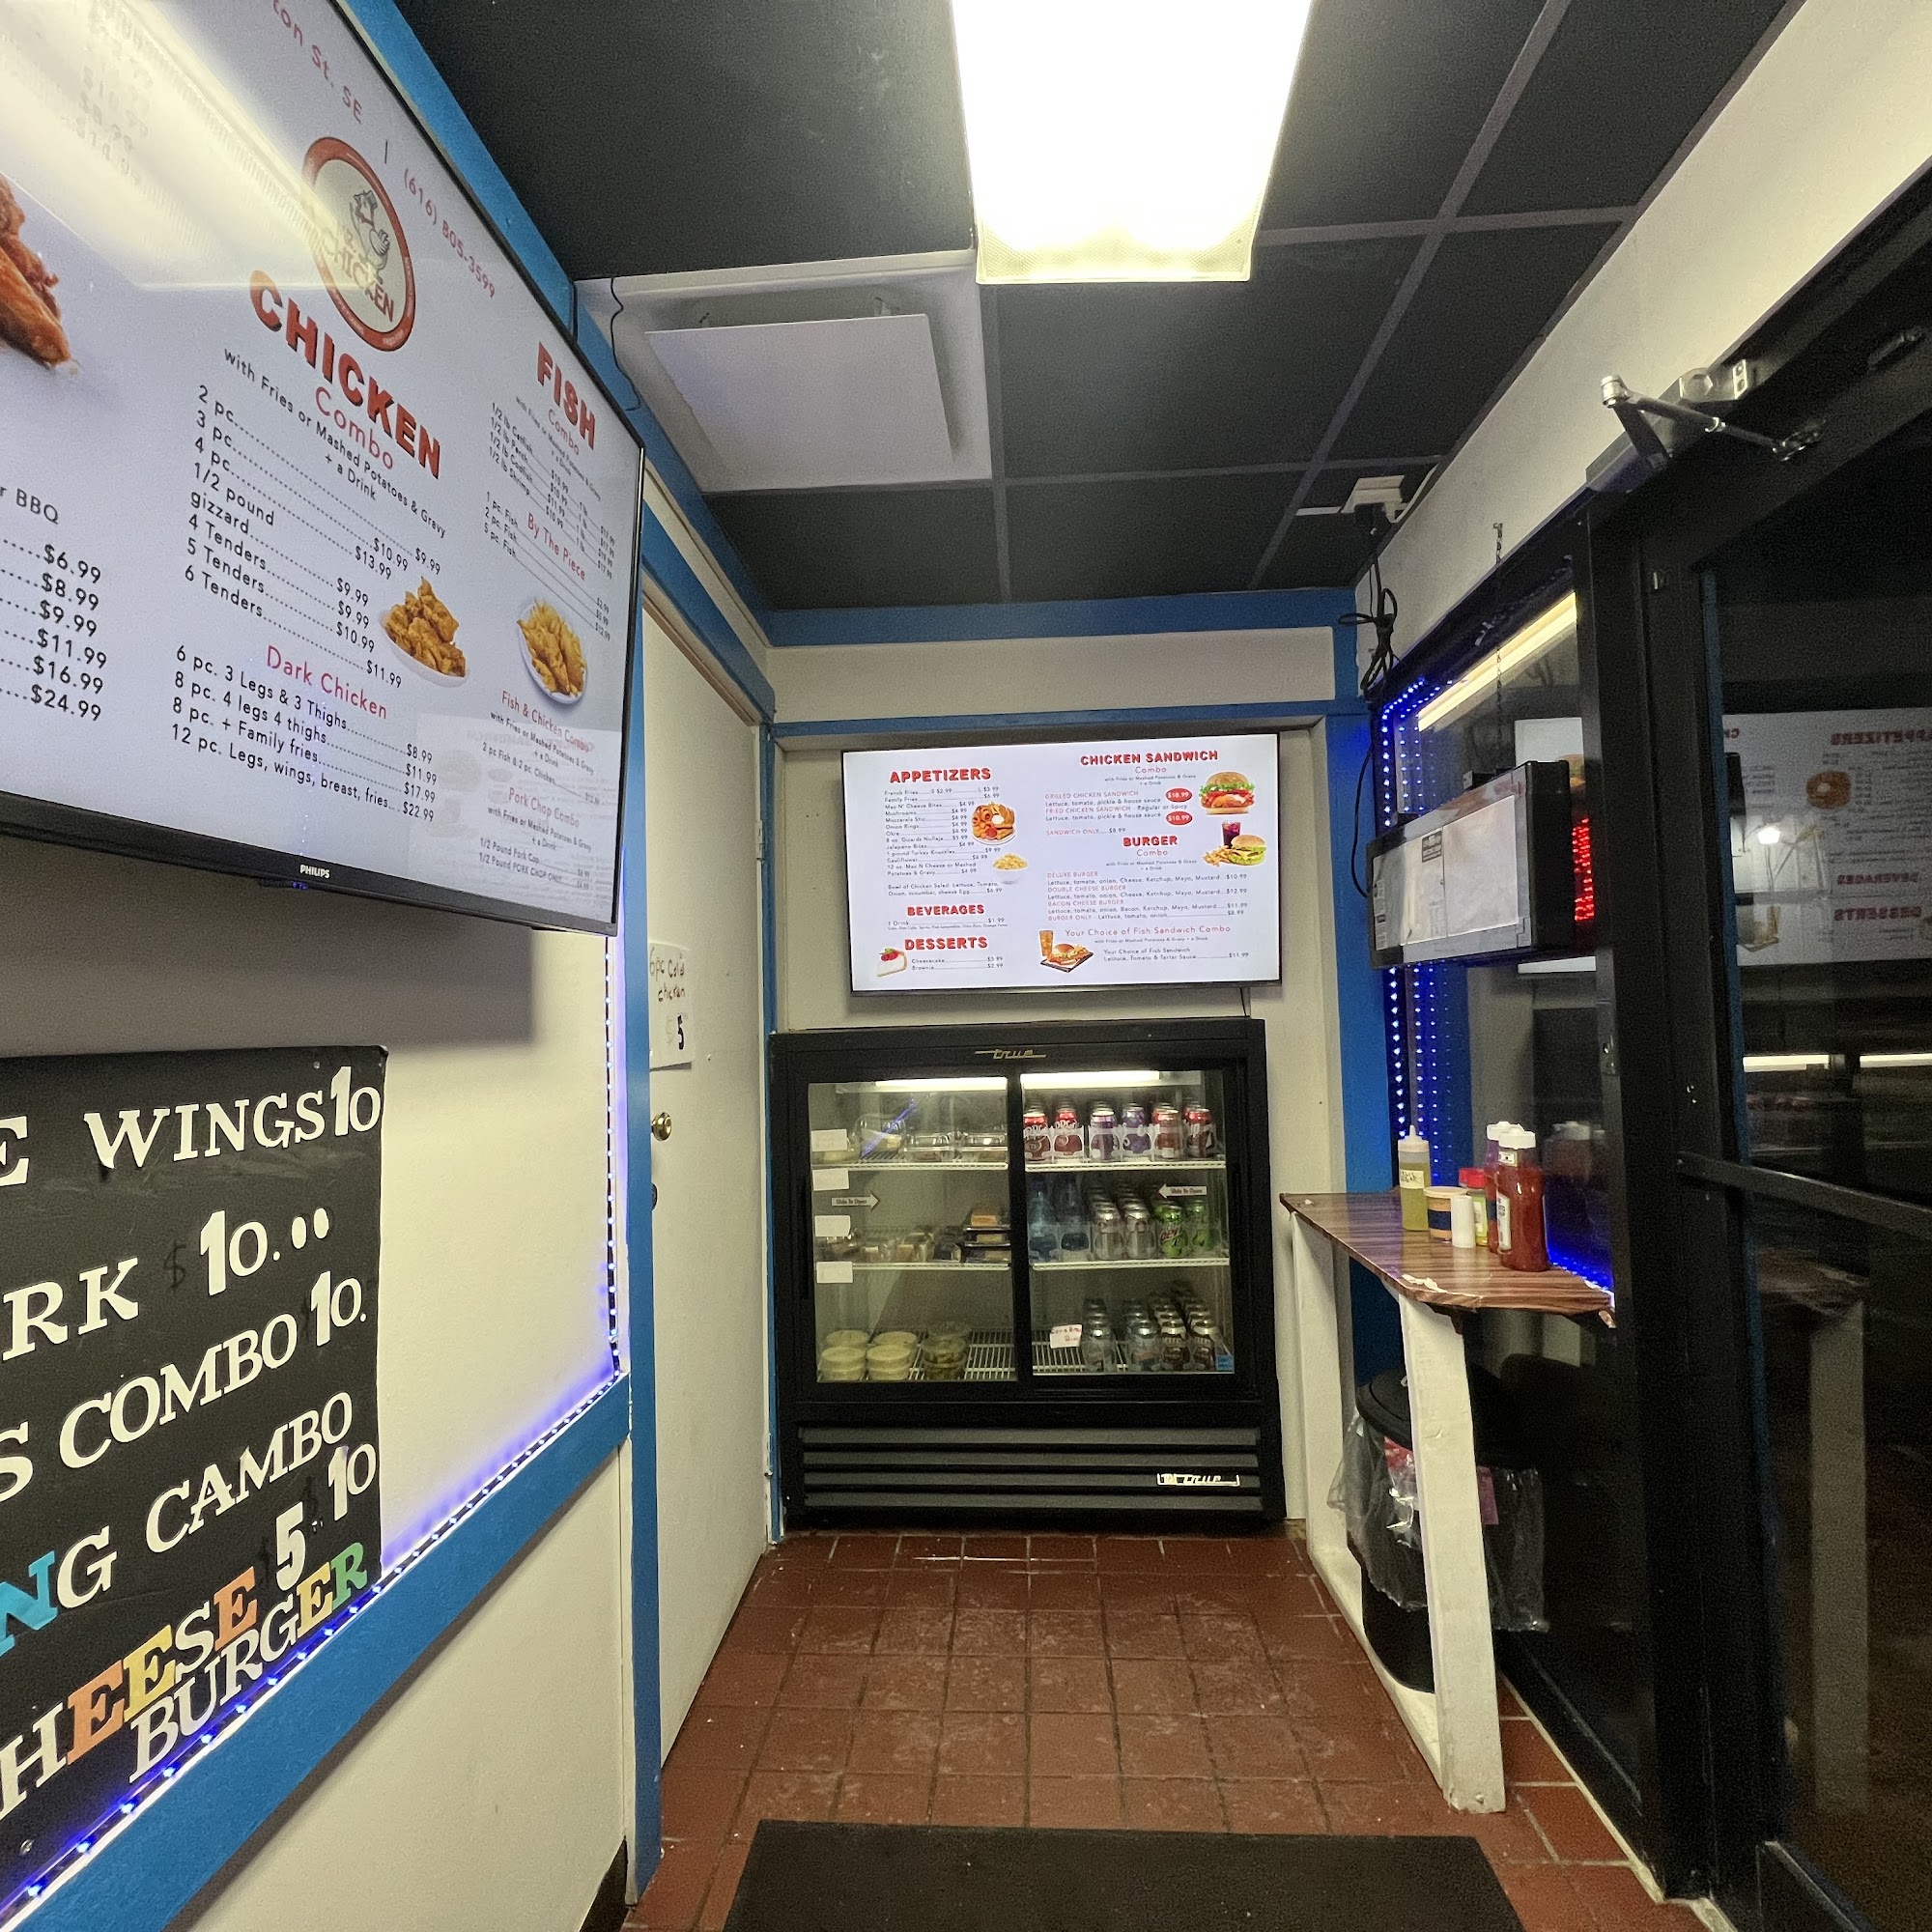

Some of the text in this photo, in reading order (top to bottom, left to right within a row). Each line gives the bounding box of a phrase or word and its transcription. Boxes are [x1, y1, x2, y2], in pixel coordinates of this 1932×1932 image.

[342, 85, 362, 124] SE
[404, 168, 496, 298] (616) 805-3599
[249, 270, 440, 480] CHICKEN
[537, 341, 596, 450] FISH
[224, 348, 445, 538] with Fries or Mashed Potatoes & Gravy
[315, 386, 393, 469] Combo
[548, 409, 580, 456] Combo
[16, 488, 59, 525] BBQ
[193, 462, 274, 526] 1/2 pound
[194, 437, 204, 454] 4
[355, 546, 392, 580] $13.99
[196, 411, 206, 428] 3
[373, 537, 409, 572] $10.99
[198, 384, 208, 404] 2
[414, 547, 441, 575] $9.99
[337, 465, 343, 474] a
[348, 468, 376, 500] Drink
[190, 491, 369, 607] gizzard $9.99
[505, 508, 519, 528] Fish
[527, 512, 585, 581] By The Piece
[42, 573, 99, 611] $8.99
[43, 544, 100, 583] $6.99
[186, 537, 375, 653] 5 Tenders $10.99
[187, 514, 370, 629] 4 Tenders $9.99
[37, 628, 107, 669] $11.99
[40, 599, 98, 638] $9.99
[185, 565, 402, 689] 6 Tenders $11.99
[30, 684, 101, 721] $24.99
[33, 655, 103, 695] $16.99
[176, 645, 433, 764] 6 pc. 3 Legs & 3 Thighs $8.99
[267, 644, 387, 720] Dark Chicken
[174, 671, 438, 784] 8 pc. 4 legs 4 thighs $11.99
[501, 690, 520, 713] Fish
[523, 703, 529, 718] &
[531, 709, 562, 737] Chicken
[172, 724, 435, 821] 12 pc. Legs, wings, breast, fries $22.99
[173, 696, 436, 804] 8 pc. + Family fries $17.99
[889, 767, 991, 783] APPETIZERS
[1080, 750, 1218, 766] CHICKEN SANDWICH
[508, 787, 580, 828] Pork Chop Combo
[1122, 835, 1179, 847] BURGER
[299, 864, 330, 879] PHILIPS
[904, 936, 988, 951] DESSERTS
[906, 904, 984, 917] BEVERAGES
[1065, 924, 1232, 937] Your Choice of Fish Sandwich Combo
[83, 1090, 327, 1169] WINGS
[329, 1065, 382, 1137] 10
[59, 1313, 298, 1469] COMBO
[145, 1392, 353, 1553] CAMBO
[327, 1443, 377, 1521] 10
[128, 1542, 368, 1783] BURGER
